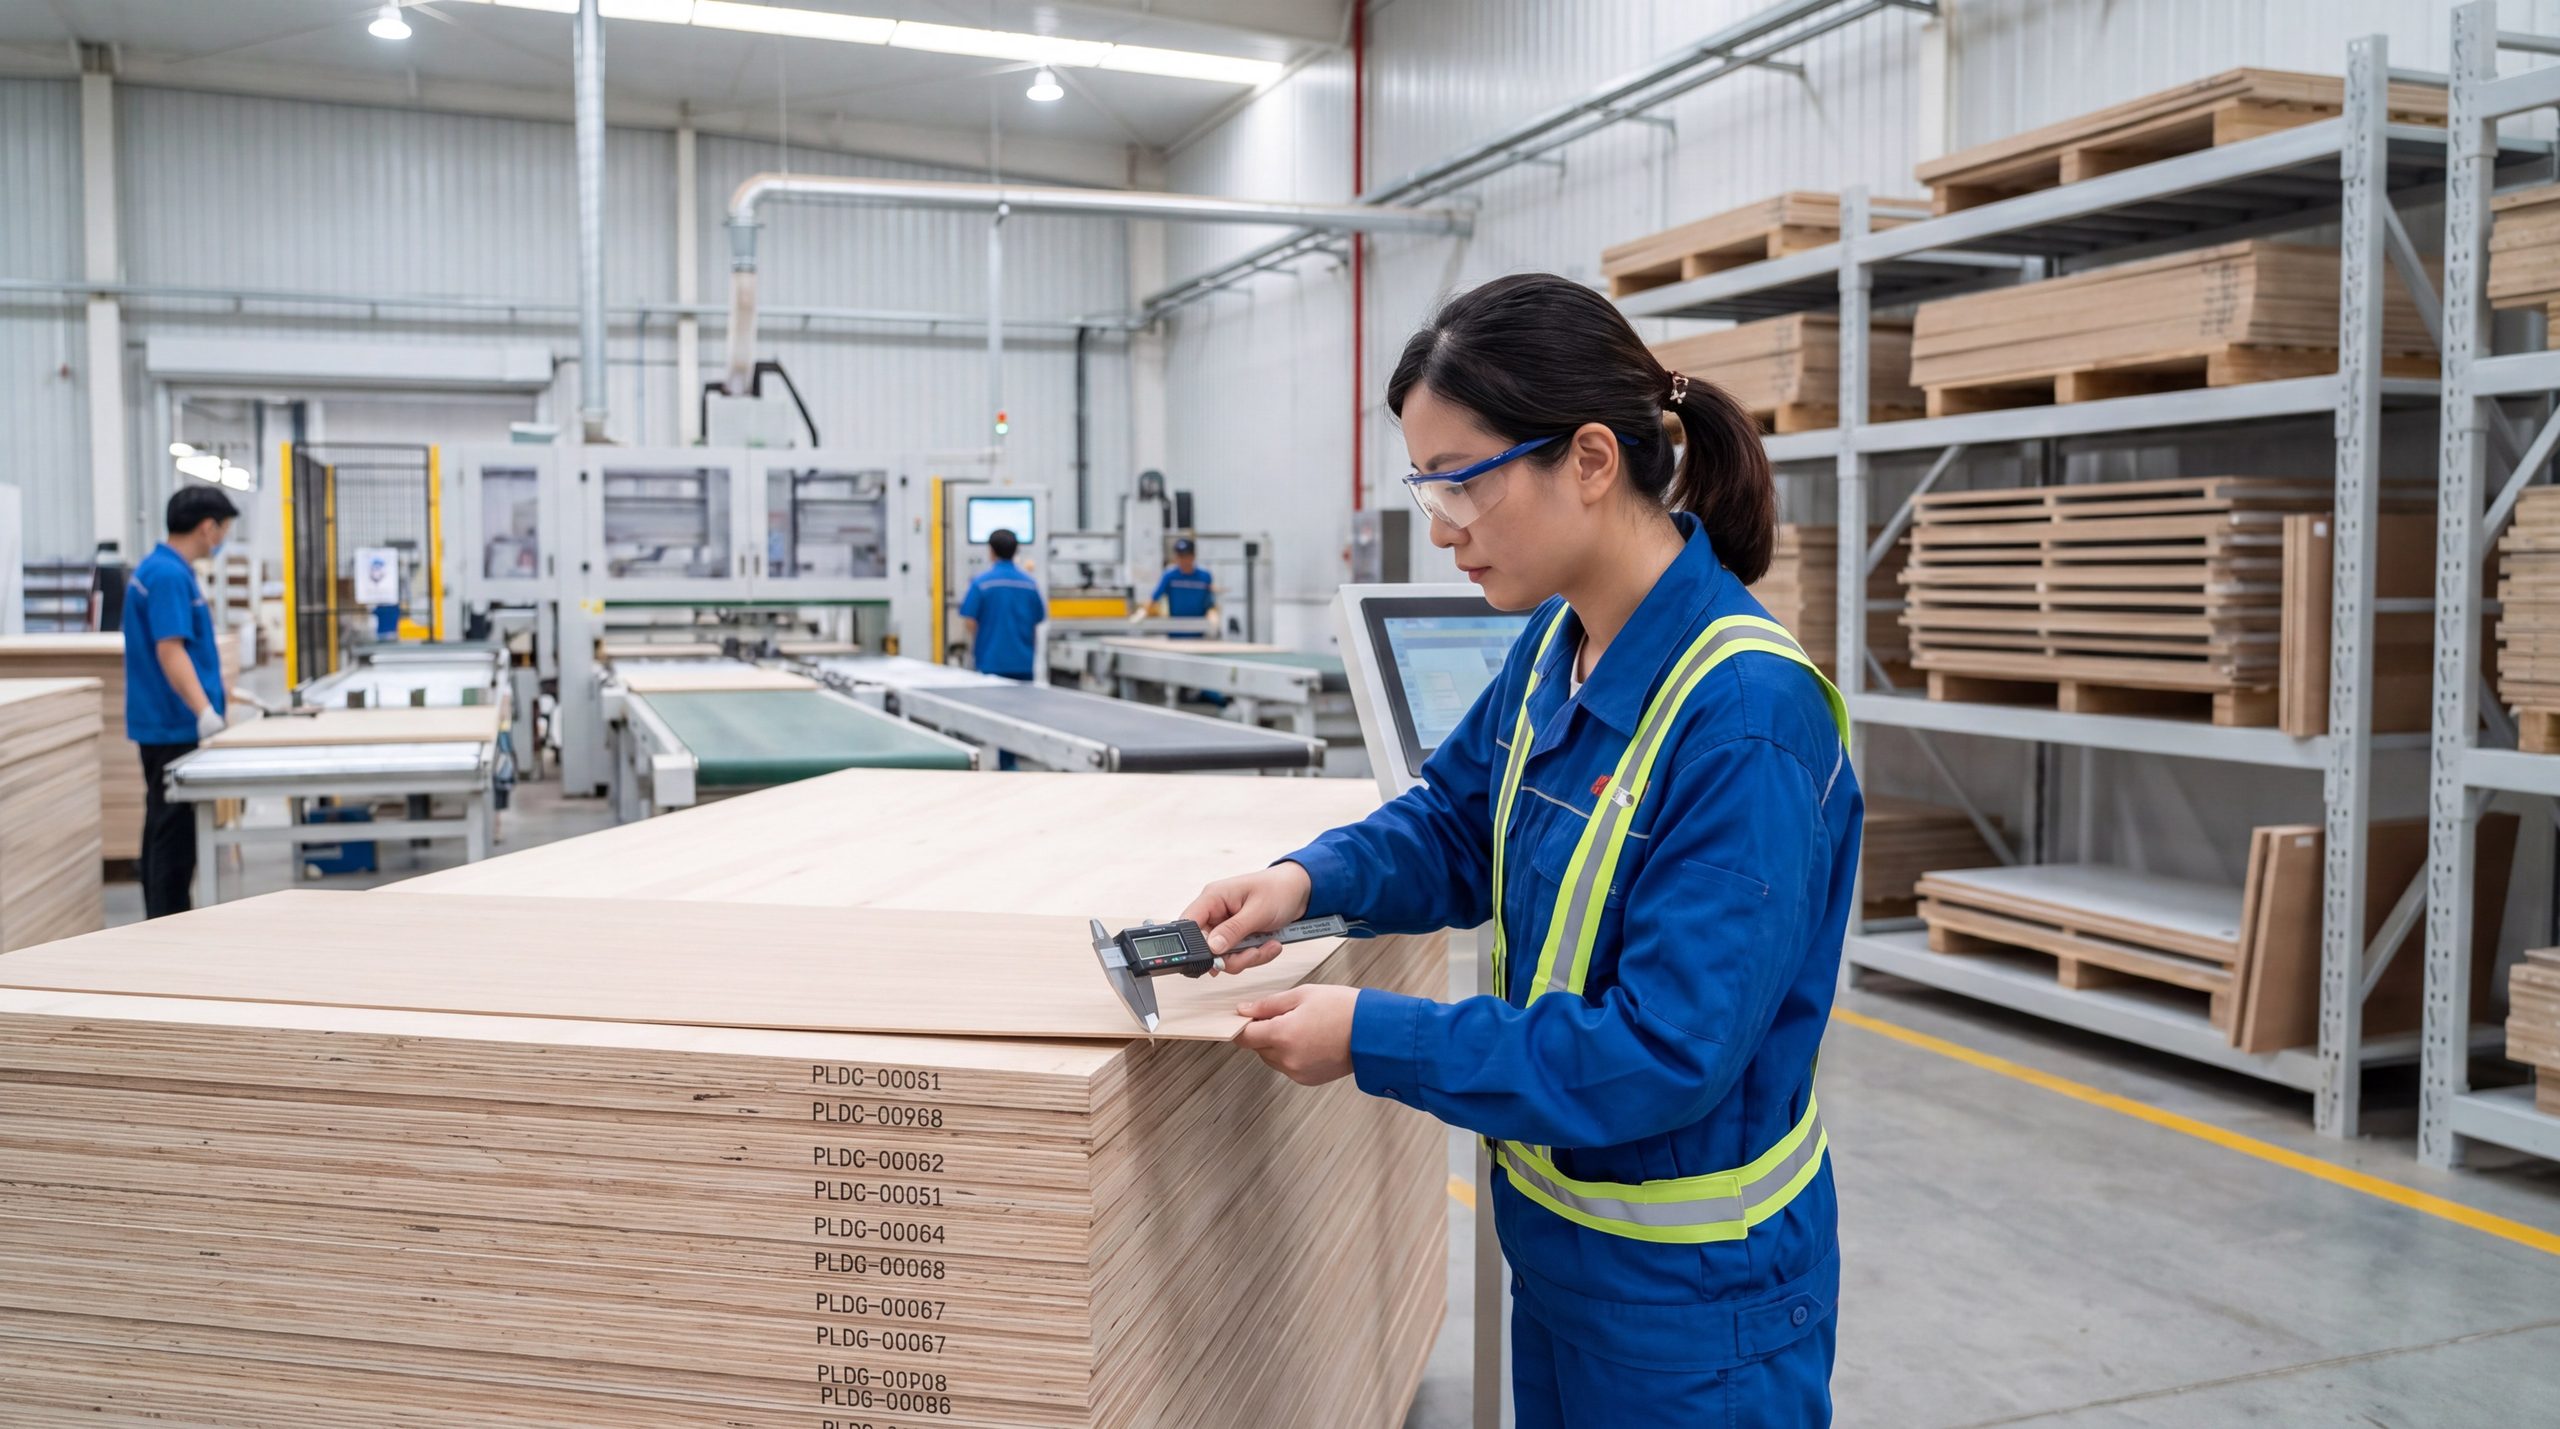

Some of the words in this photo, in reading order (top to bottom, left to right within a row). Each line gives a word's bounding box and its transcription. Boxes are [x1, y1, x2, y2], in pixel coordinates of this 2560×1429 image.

[812, 1102, 943, 1128] PLDC-00968
[814, 1146, 944, 1173] PLDC-00062
[814, 1180, 944, 1207] PLDC-00051
[815, 1252, 946, 1280] PLDG-00068
[816, 1292, 946, 1321] PLDG-00067
[816, 1326, 946, 1354] PLDG-00067
[820, 1386, 951, 1415] PLDG-00086
